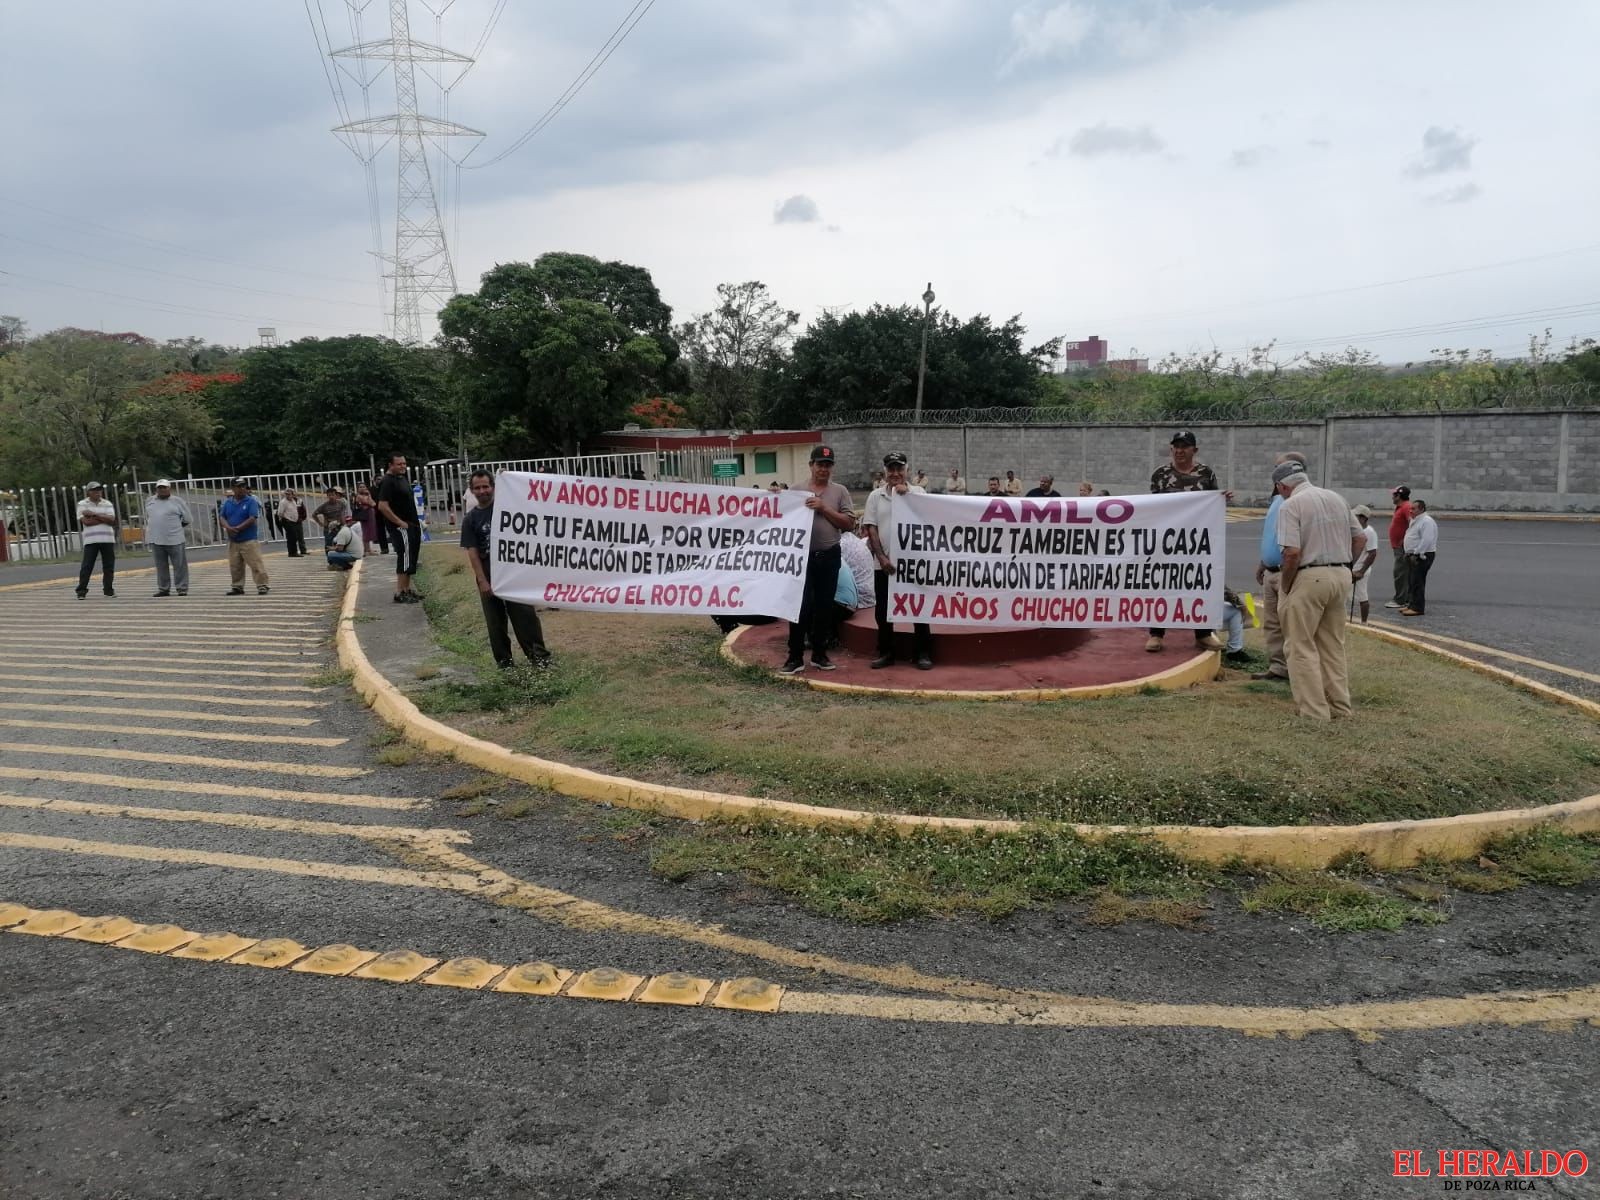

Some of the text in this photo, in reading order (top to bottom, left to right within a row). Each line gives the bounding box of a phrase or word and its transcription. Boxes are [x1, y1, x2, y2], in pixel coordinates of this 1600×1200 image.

[528, 479, 783, 518] XV AÑOS DE LUCHA SOCIAL
[979, 499, 1134, 524] AMLO
[500, 511, 806, 549] POR TU FAMILIA, POR VERACRUZ
[898, 523, 1211, 555] VERACRUZ TAMBIEN ES TU CASA
[498, 539, 803, 577] RECLASIFICACIÓN DE TARIFAS ELÉCTRICAS
[896, 555, 1212, 590] RECLASIFICACIÓN DE TARIFAS ELÉCTRICAS
[544, 582, 744, 608] CHUCHO EL ROTO A.C.
[893, 592, 1208, 623] XV AÑOS CHUCHO EL ROTO A.C.
